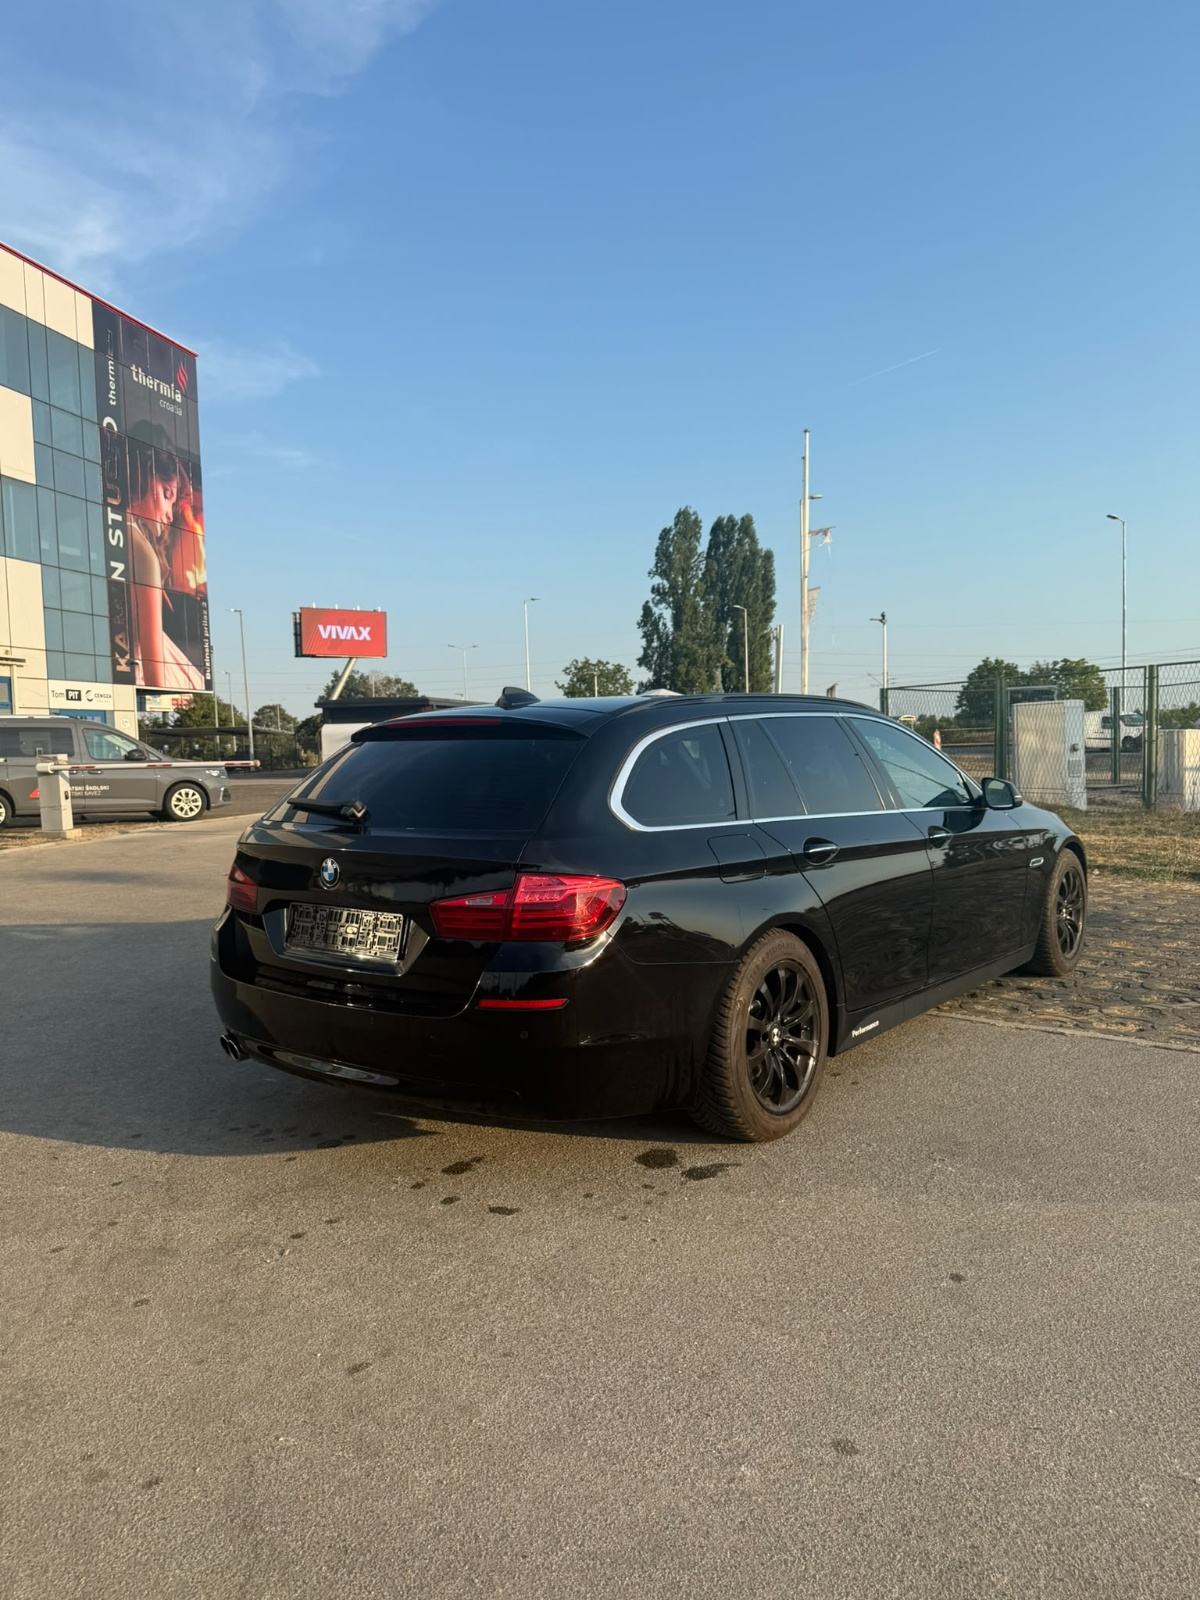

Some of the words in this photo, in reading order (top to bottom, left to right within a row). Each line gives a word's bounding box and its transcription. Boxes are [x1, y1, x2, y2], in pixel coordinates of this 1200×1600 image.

[130, 363, 183, 404] thermia
[109, 560, 132, 673] KAN
[317, 623, 372, 641] VIVAX
[67, 690, 80, 700] PIT
